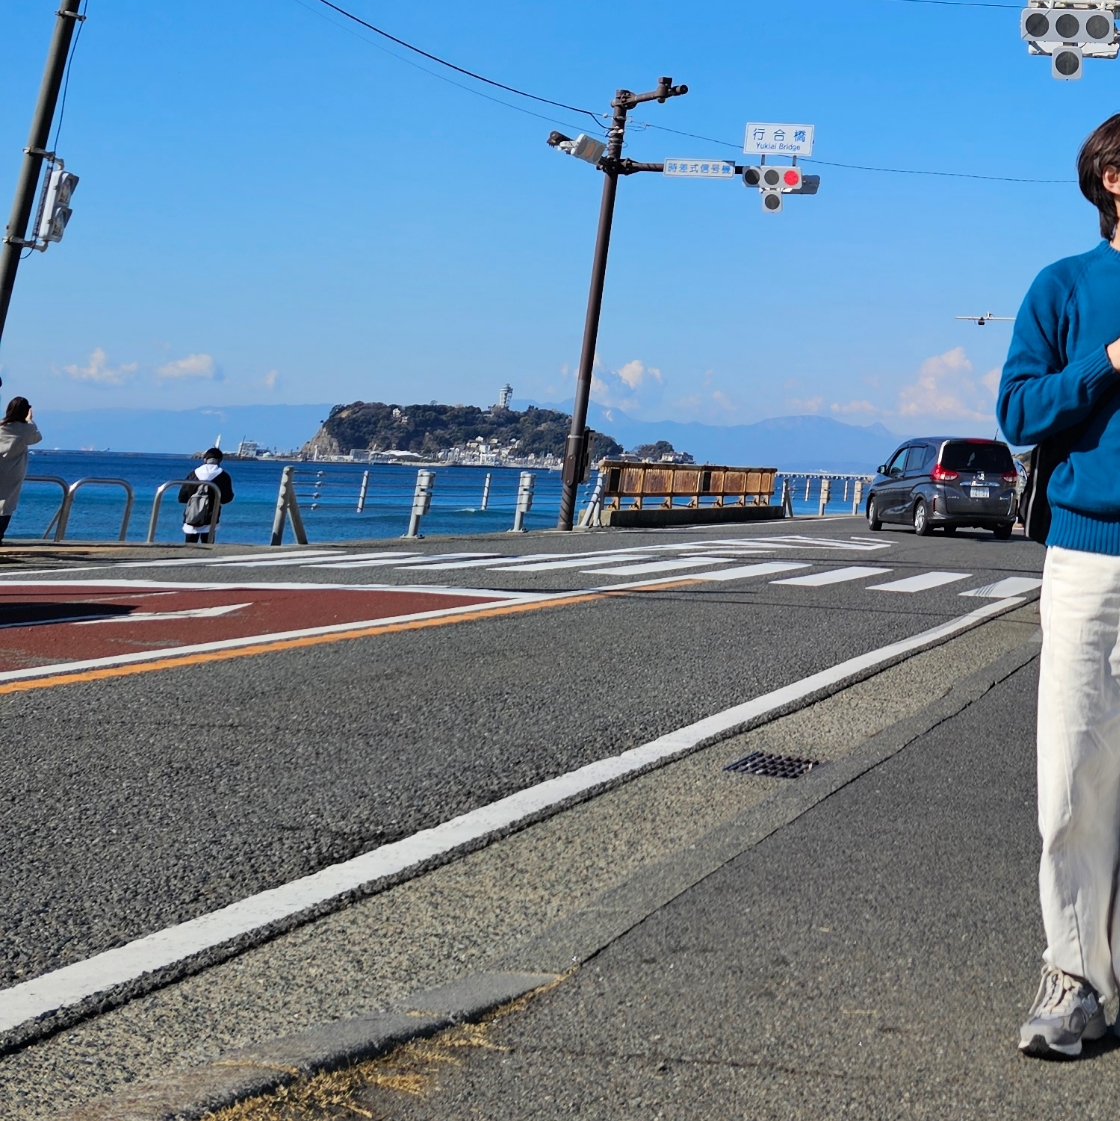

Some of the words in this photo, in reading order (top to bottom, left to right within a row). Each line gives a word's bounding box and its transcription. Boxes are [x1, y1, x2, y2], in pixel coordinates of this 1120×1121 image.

[753, 128, 806, 142] 行合橋
[779, 143, 800, 151] Bridge
